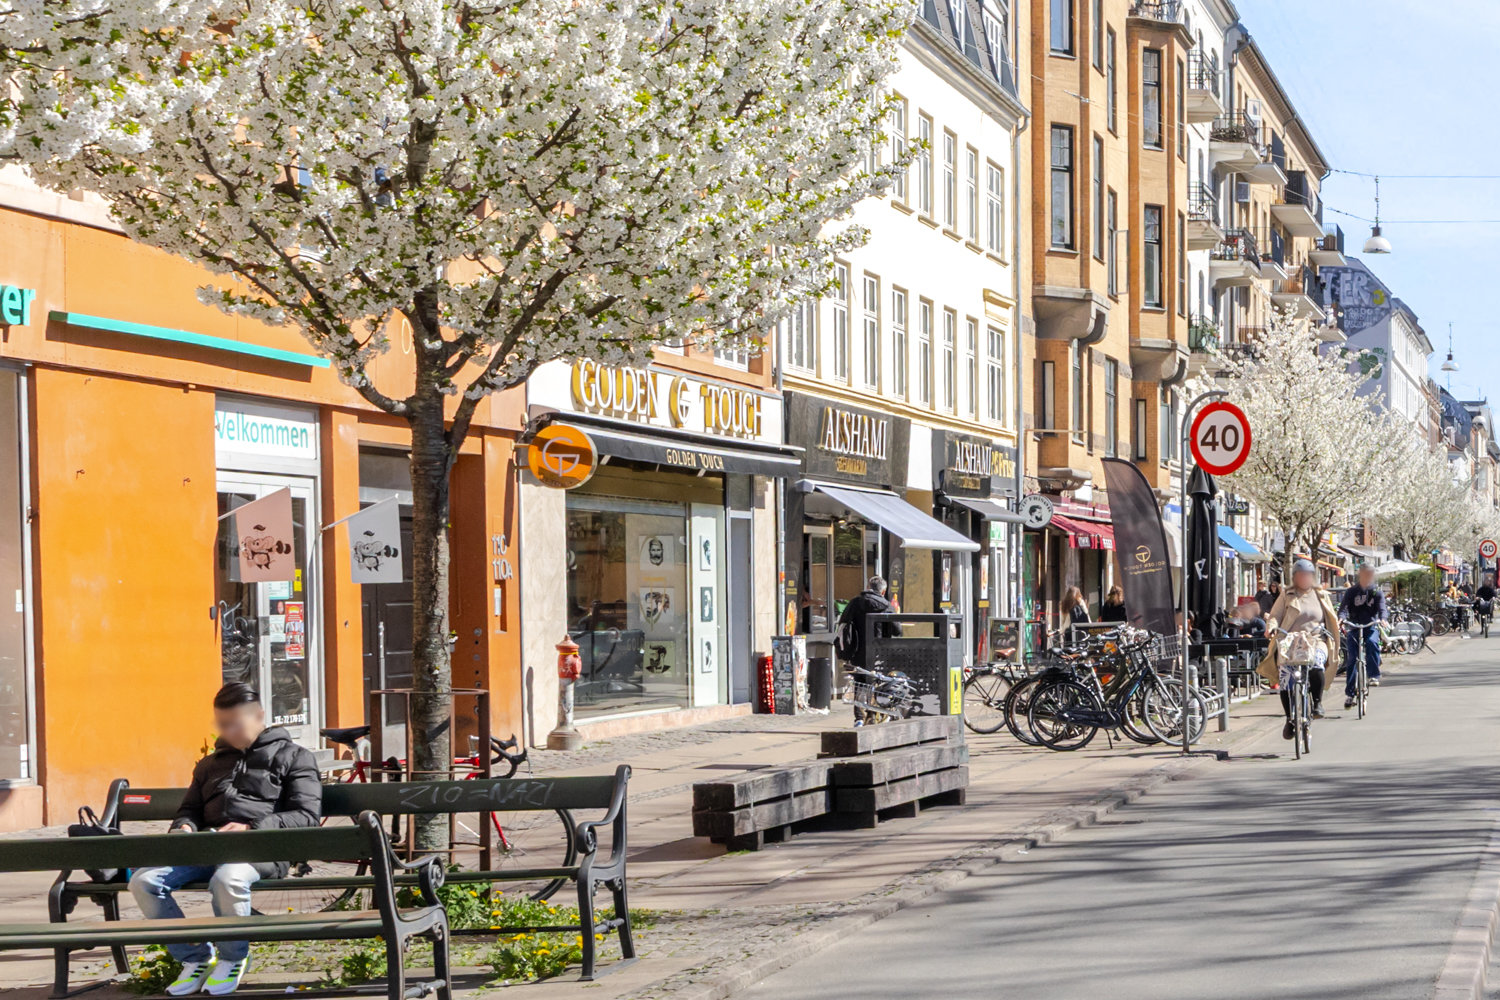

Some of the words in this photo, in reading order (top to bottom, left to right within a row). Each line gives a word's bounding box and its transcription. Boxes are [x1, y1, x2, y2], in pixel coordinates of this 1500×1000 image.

[0, 284, 36, 326] er
[573, 357, 661, 417] GOLDEN
[701, 384, 763, 435] TOUCH
[215, 409, 309, 448] Velkommen
[821, 406, 887, 460] ALSHAMI
[1200, 424, 1239, 452] 40
[666, 448, 697, 467] GOLDEN
[699, 453, 725, 470] TOUCH
[954, 440, 992, 476] ALSHAMI
[492, 534, 507, 555] 110
